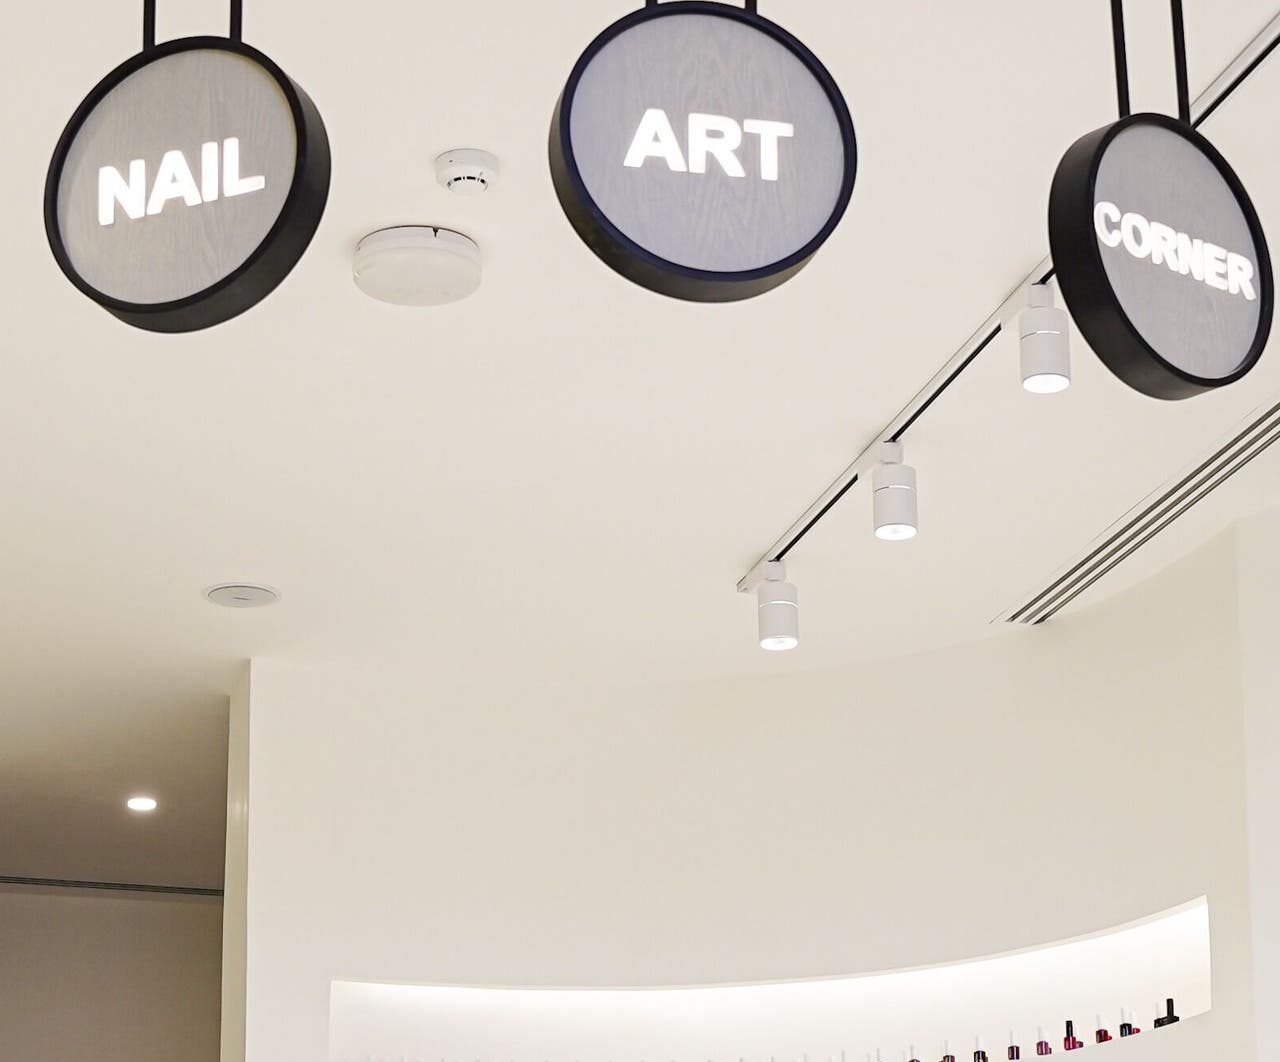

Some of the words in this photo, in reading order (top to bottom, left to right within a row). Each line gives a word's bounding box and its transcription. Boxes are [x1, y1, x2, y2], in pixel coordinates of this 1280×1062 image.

[98, 137, 266, 226] NAIL
[623, 108, 794, 181] ART
[1093, 201, 1257, 301] CORNER
